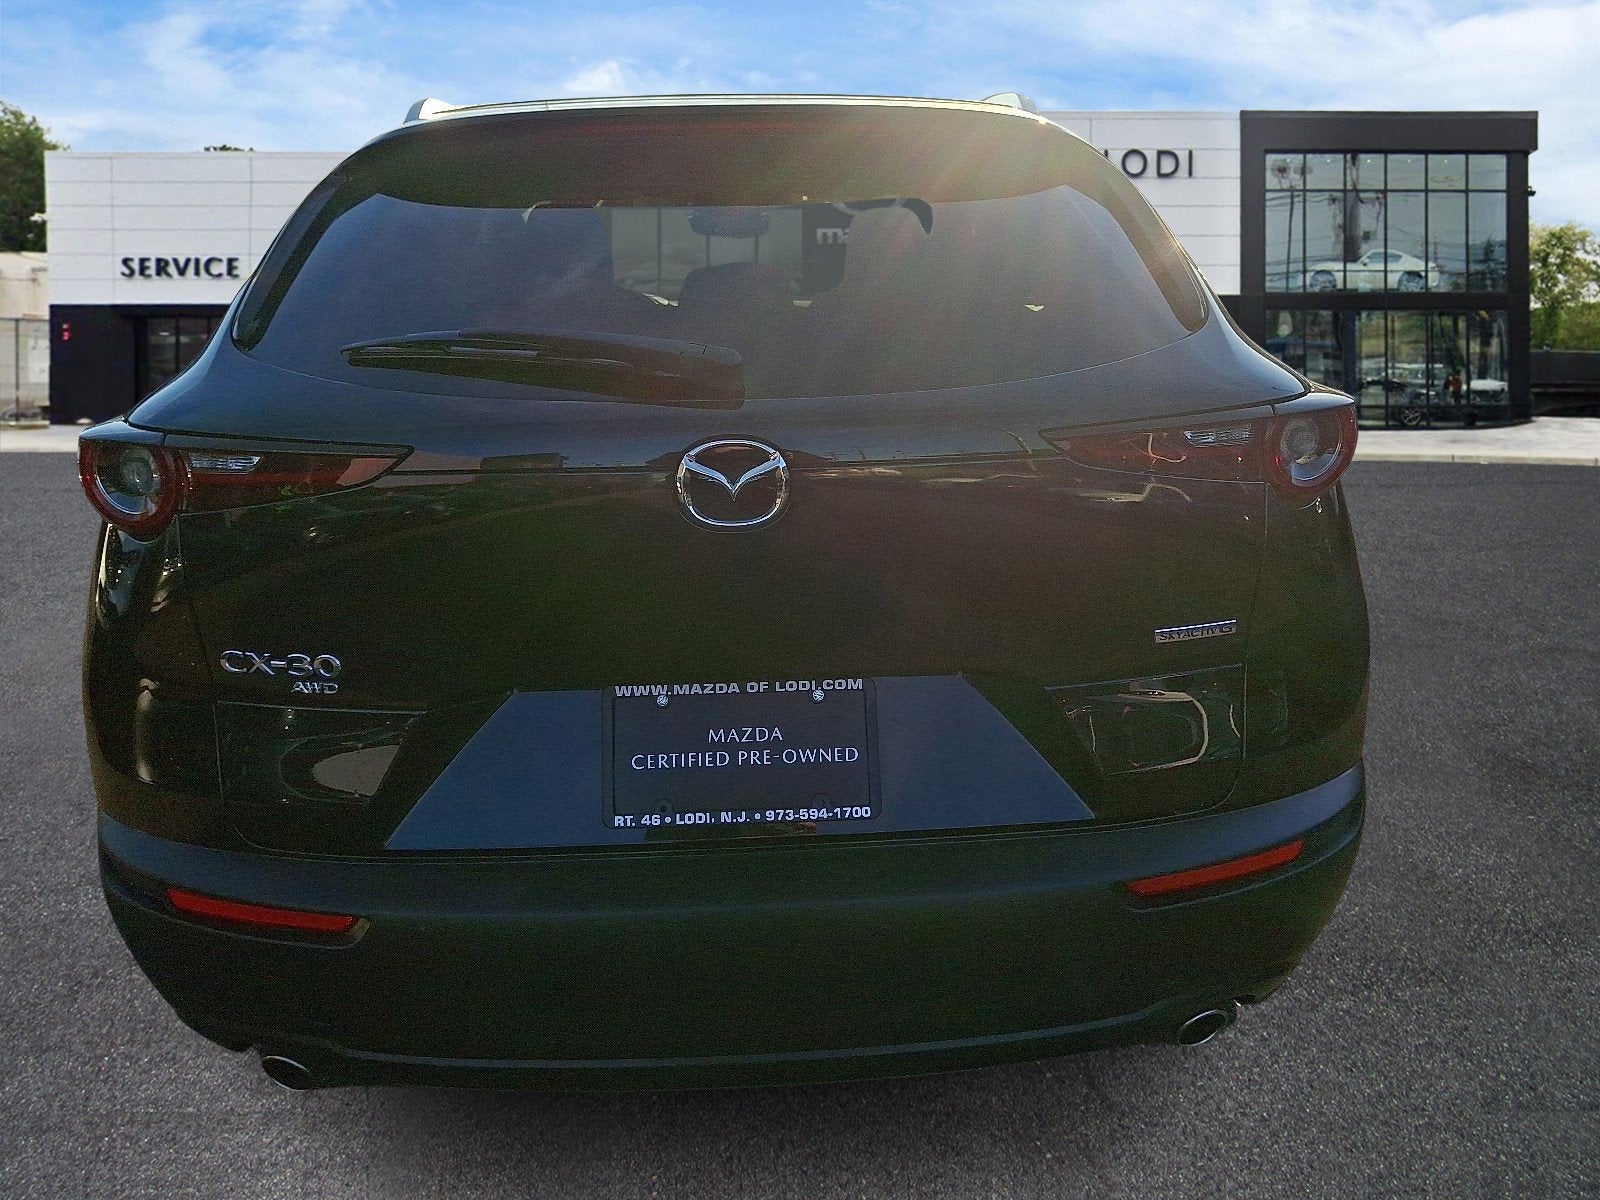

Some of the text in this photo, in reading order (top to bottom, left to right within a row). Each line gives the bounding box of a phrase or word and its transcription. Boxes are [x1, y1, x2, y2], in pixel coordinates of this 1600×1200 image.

[1104, 148, 1193, 178] ODI
[120, 257, 240, 278] SERVICE
[219, 650, 342, 678] CX-30
[290, 681, 339, 694] AWD
[614, 678, 863, 697] WWW.MAZDA OF LODI.COM
[708, 726, 784, 744] MAZDA
[631, 747, 859, 770] CERTIFIED PRE-OWNED
[614, 815, 636, 827] RT.
[641, 814, 661, 826] 46
[720, 811, 750, 823] N.J.
[765, 806, 871, 821] 973-594-1700
